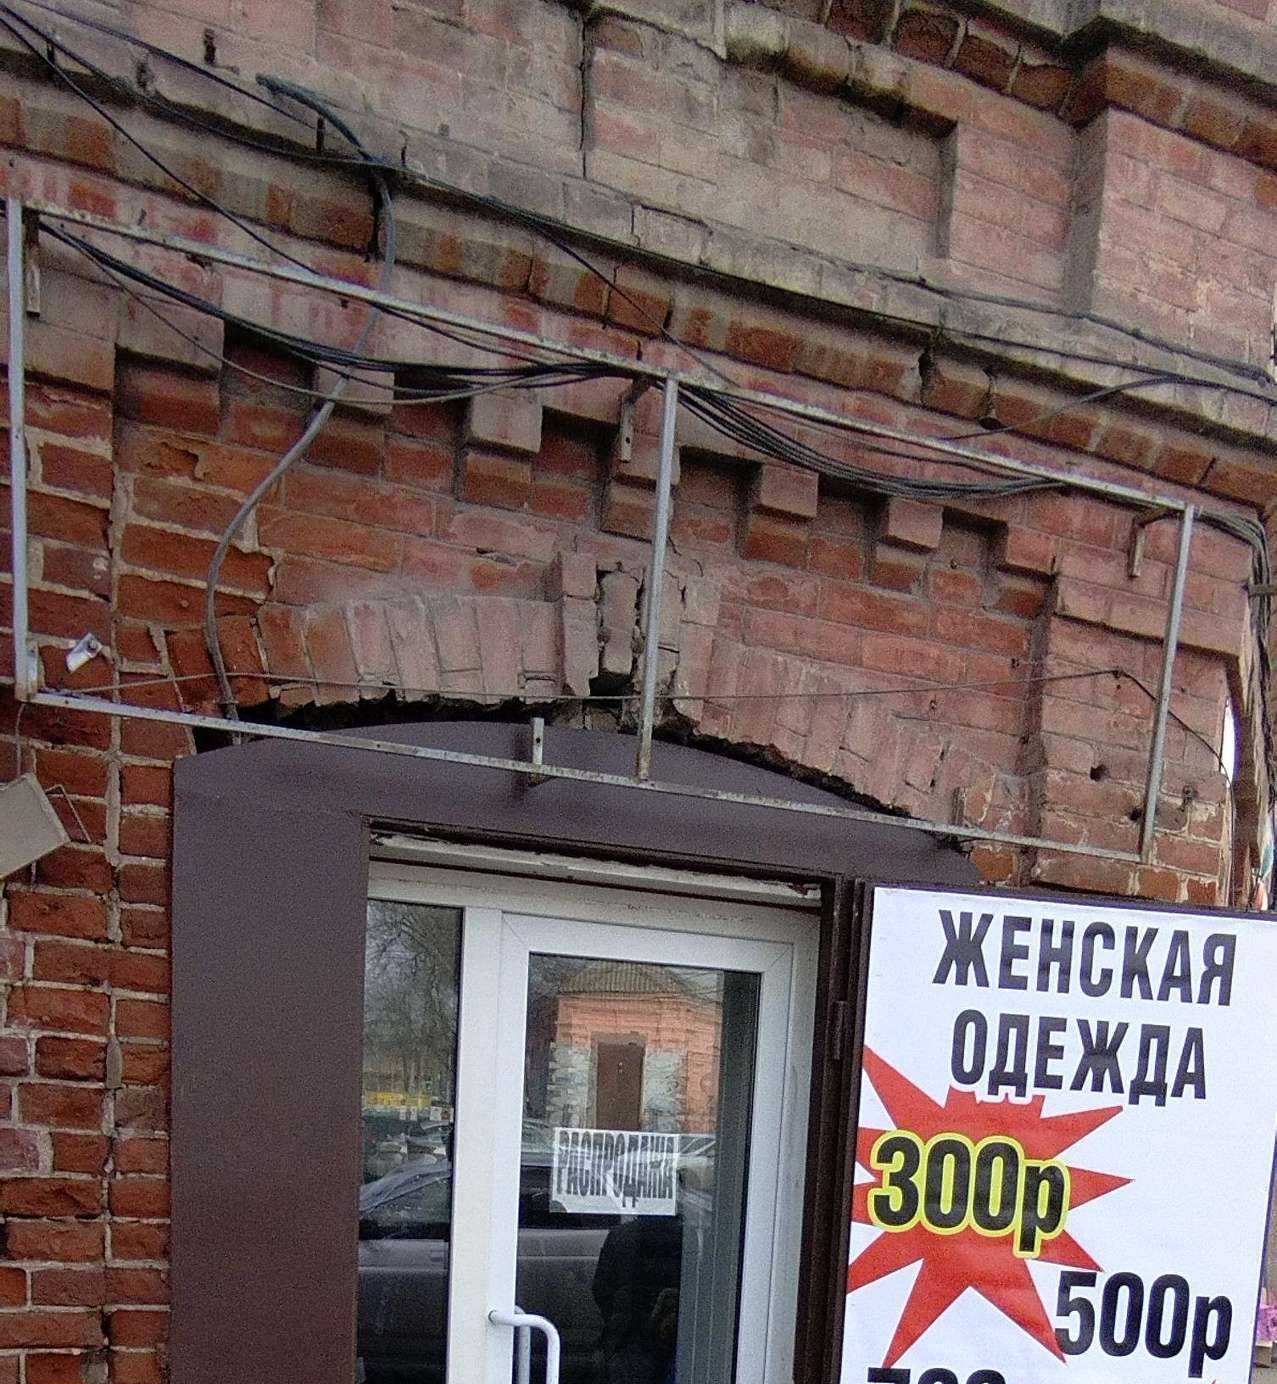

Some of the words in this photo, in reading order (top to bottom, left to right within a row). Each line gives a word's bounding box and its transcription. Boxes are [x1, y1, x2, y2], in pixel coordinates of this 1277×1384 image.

[932, 909, 1237, 1006] ЖЕНСКАЯ
[950, 1009, 1206, 1107] ОДЕЖДА
[872, 1133, 1068, 1255] 300р
[1055, 1271, 1233, 1378] 500р
